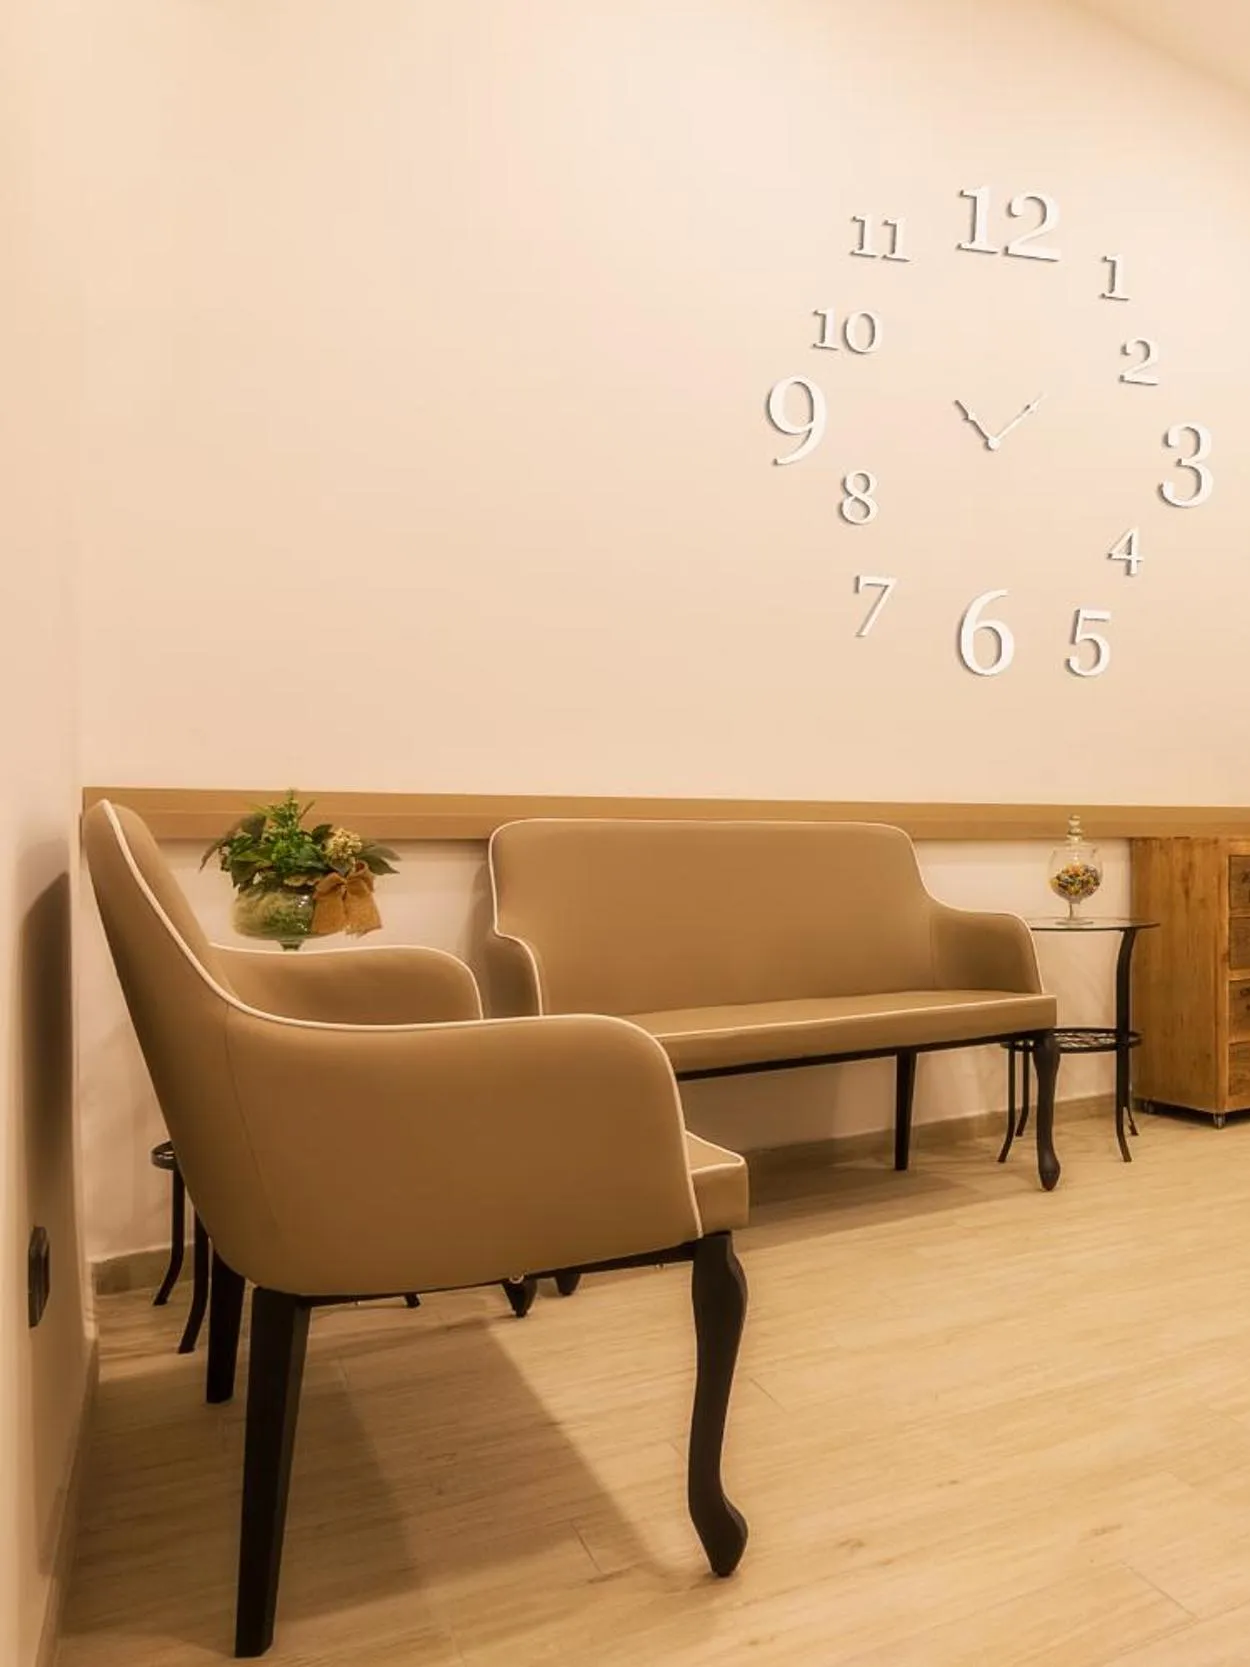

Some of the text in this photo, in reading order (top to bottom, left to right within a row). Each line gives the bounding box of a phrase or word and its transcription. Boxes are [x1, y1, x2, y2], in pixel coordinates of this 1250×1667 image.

[850, 213, 912, 263] 11
[956, 185, 1063, 263] 12
[1100, 253, 1130, 302] 1
[811, 307, 883, 355] 10
[1118, 338, 1161, 387] 2
[765, 375, 828, 467] 9
[1158, 421, 1214, 509] 3
[838, 470, 879, 526] 8
[1107, 527, 1144, 578] 4
[855, 574, 897, 639] 7
[957, 588, 1016, 677] 6
[1066, 608, 1112, 678] 5
